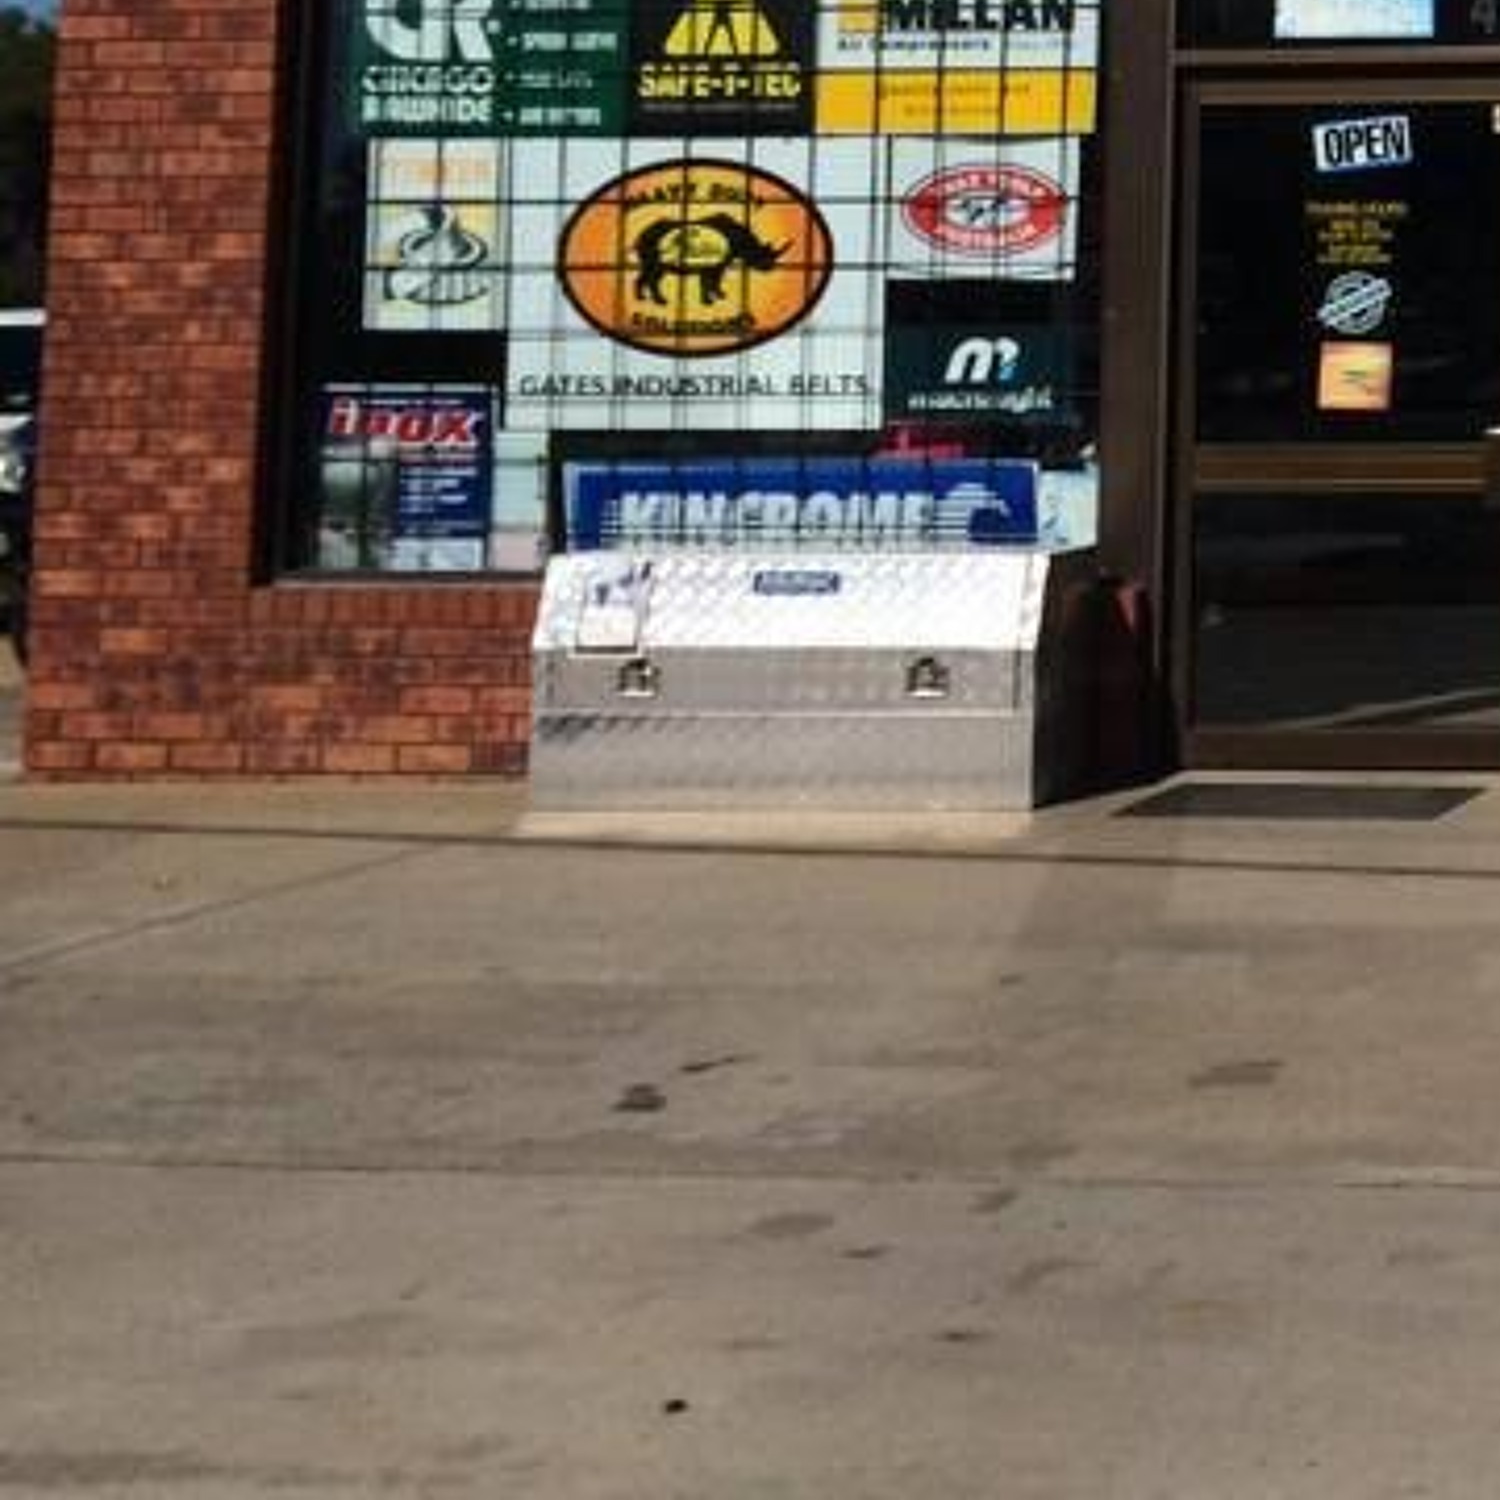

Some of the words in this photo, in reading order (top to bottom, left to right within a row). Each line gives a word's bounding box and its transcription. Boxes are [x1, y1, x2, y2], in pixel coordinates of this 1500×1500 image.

[1324, 118, 1408, 166] OPEN
[519, 375, 604, 396] GATES
[613, 375, 780, 396] INDUSTRIAL
[790, 374, 868, 395] BELTS
